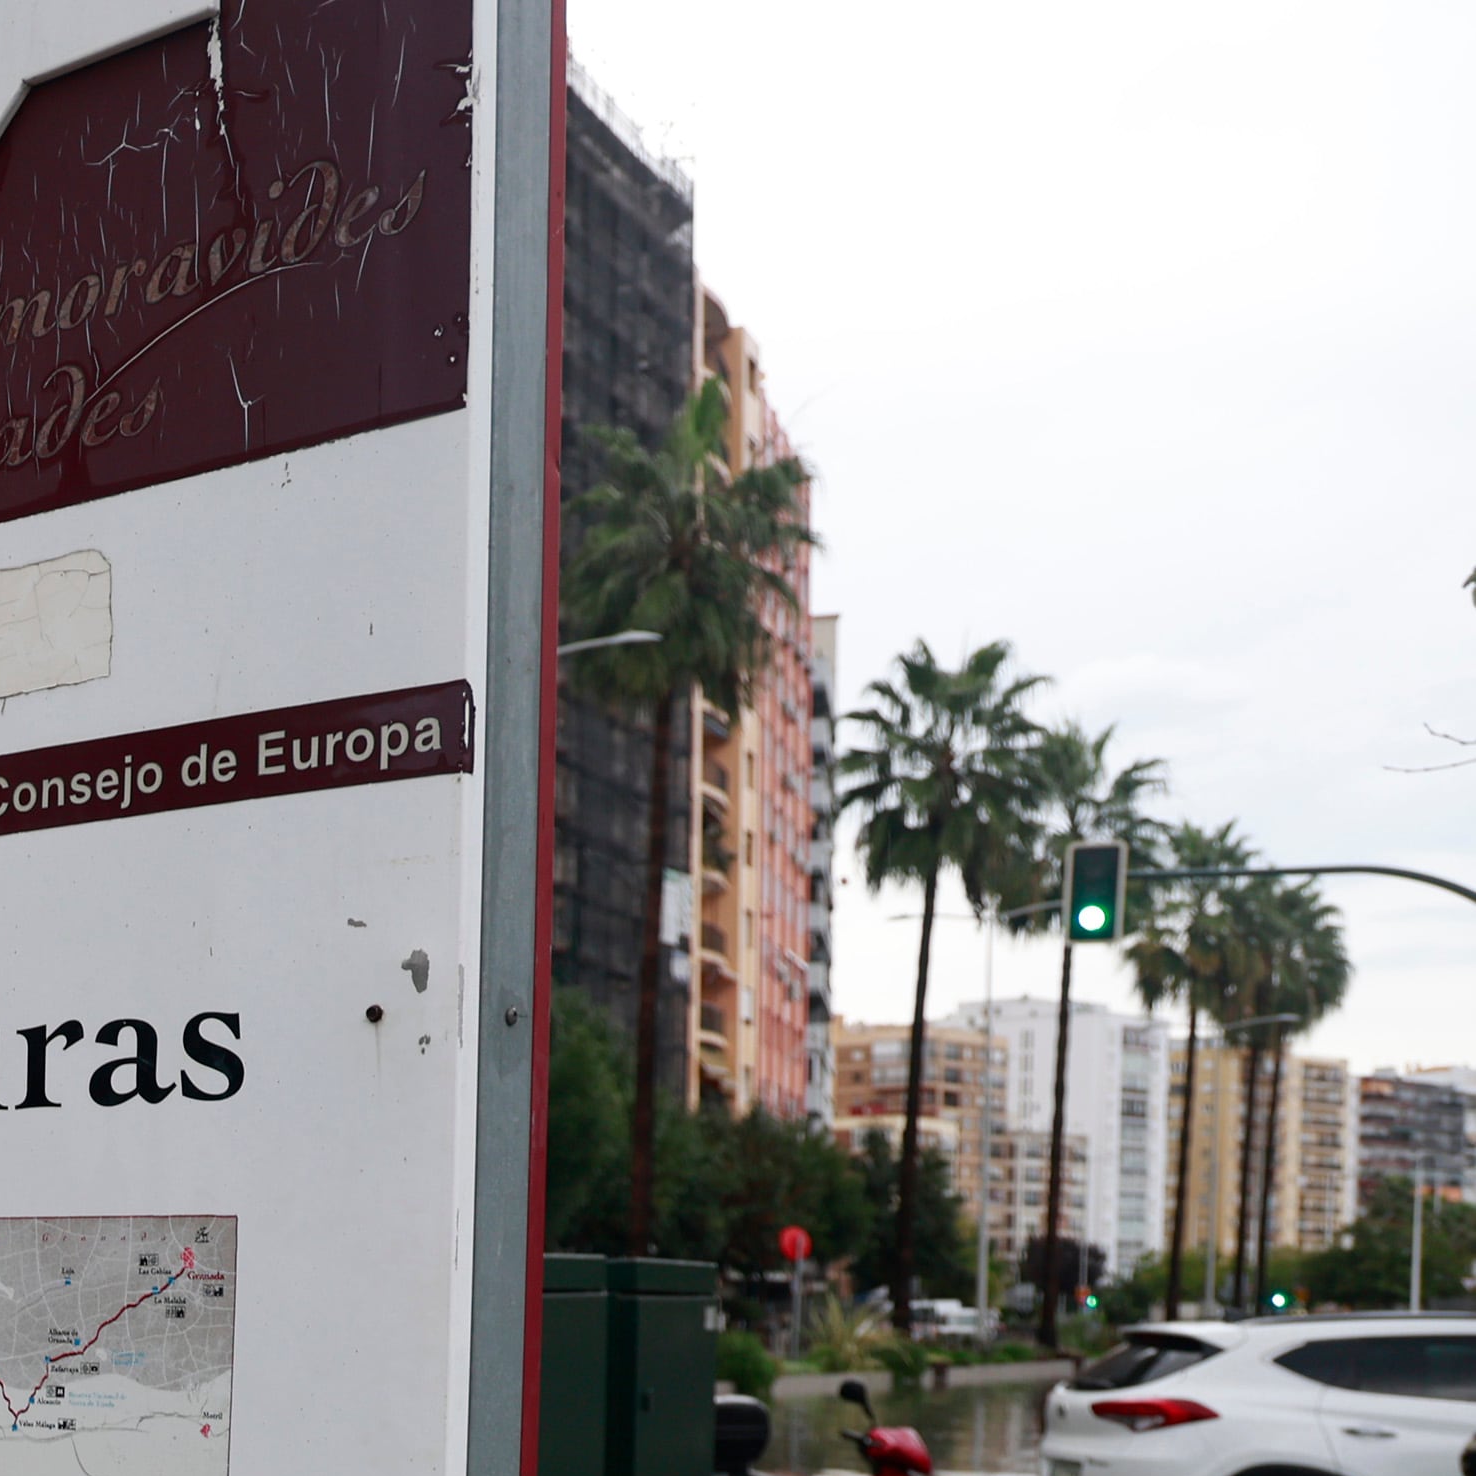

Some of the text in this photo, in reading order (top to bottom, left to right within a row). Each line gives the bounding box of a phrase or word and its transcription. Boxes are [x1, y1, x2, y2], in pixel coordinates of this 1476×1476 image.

[181, 743, 238, 787] de
[256, 715, 444, 777] Europa
[187, 1270, 226, 1281] Granada
